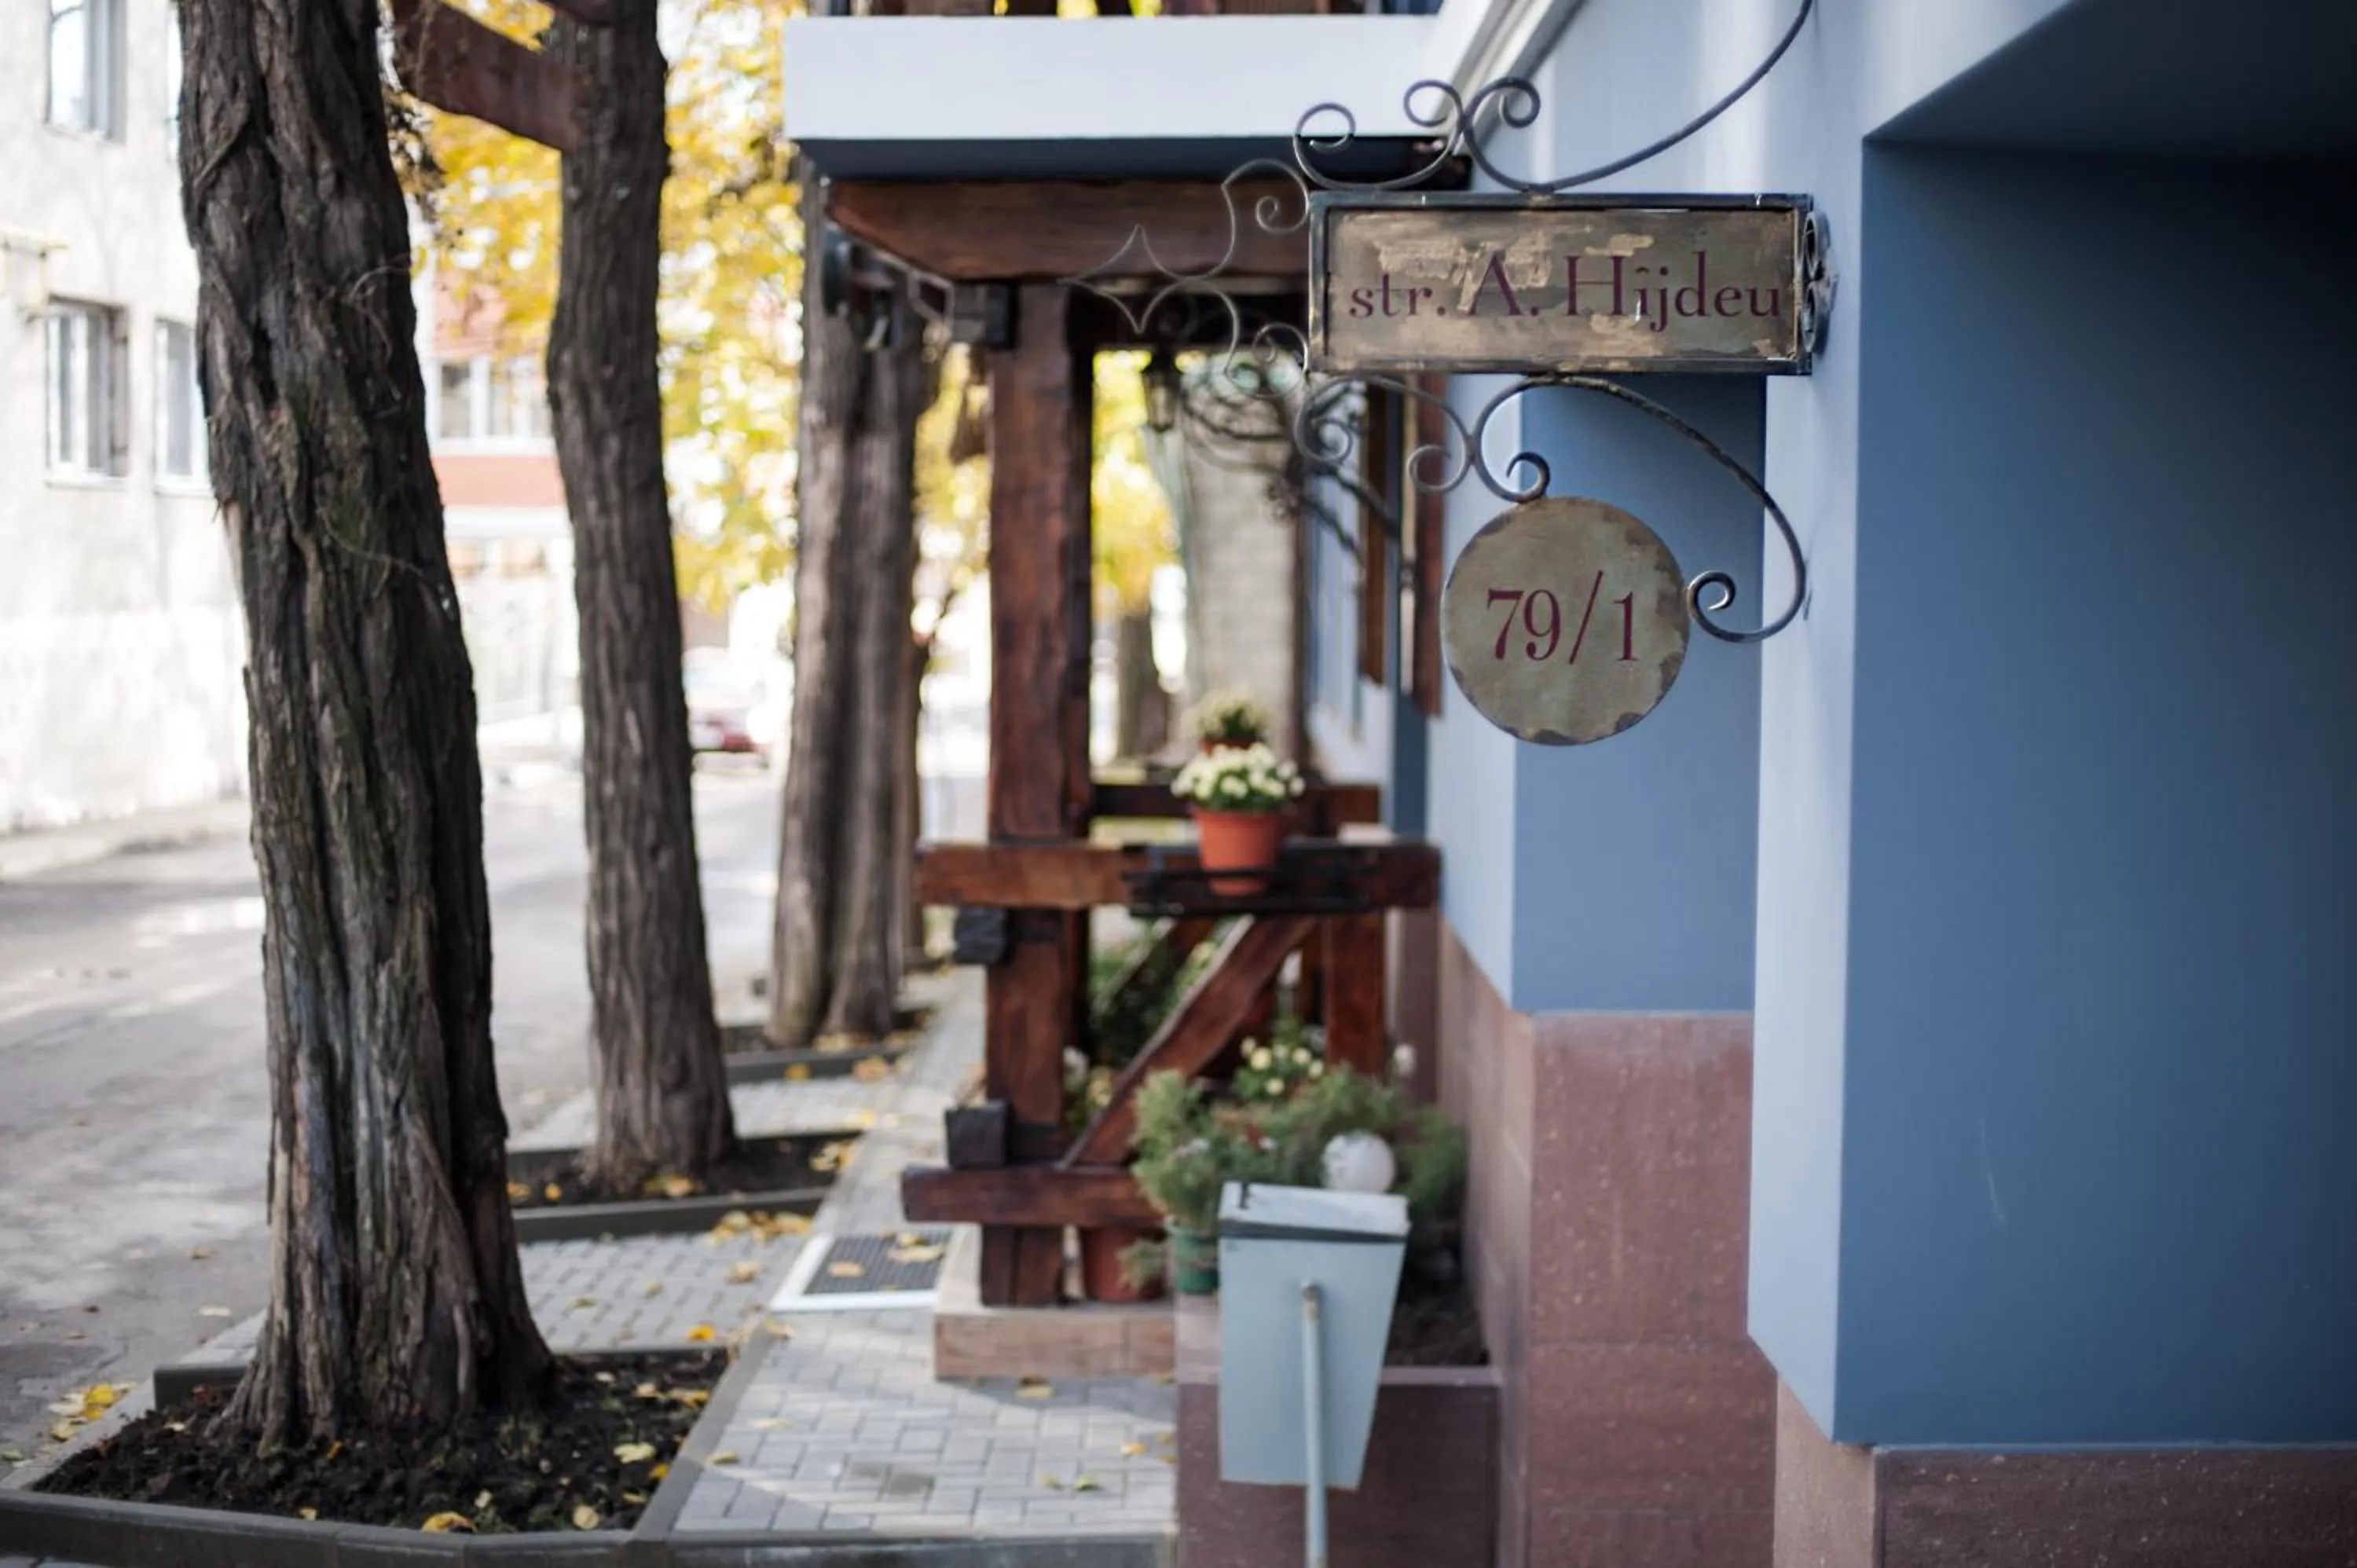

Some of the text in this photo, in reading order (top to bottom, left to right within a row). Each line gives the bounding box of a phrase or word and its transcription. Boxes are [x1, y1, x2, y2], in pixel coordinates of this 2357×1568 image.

[1349, 273, 1446, 318] str.
[1465, 251, 1538, 317] A.
[1486, 570, 1638, 665] 79/1
